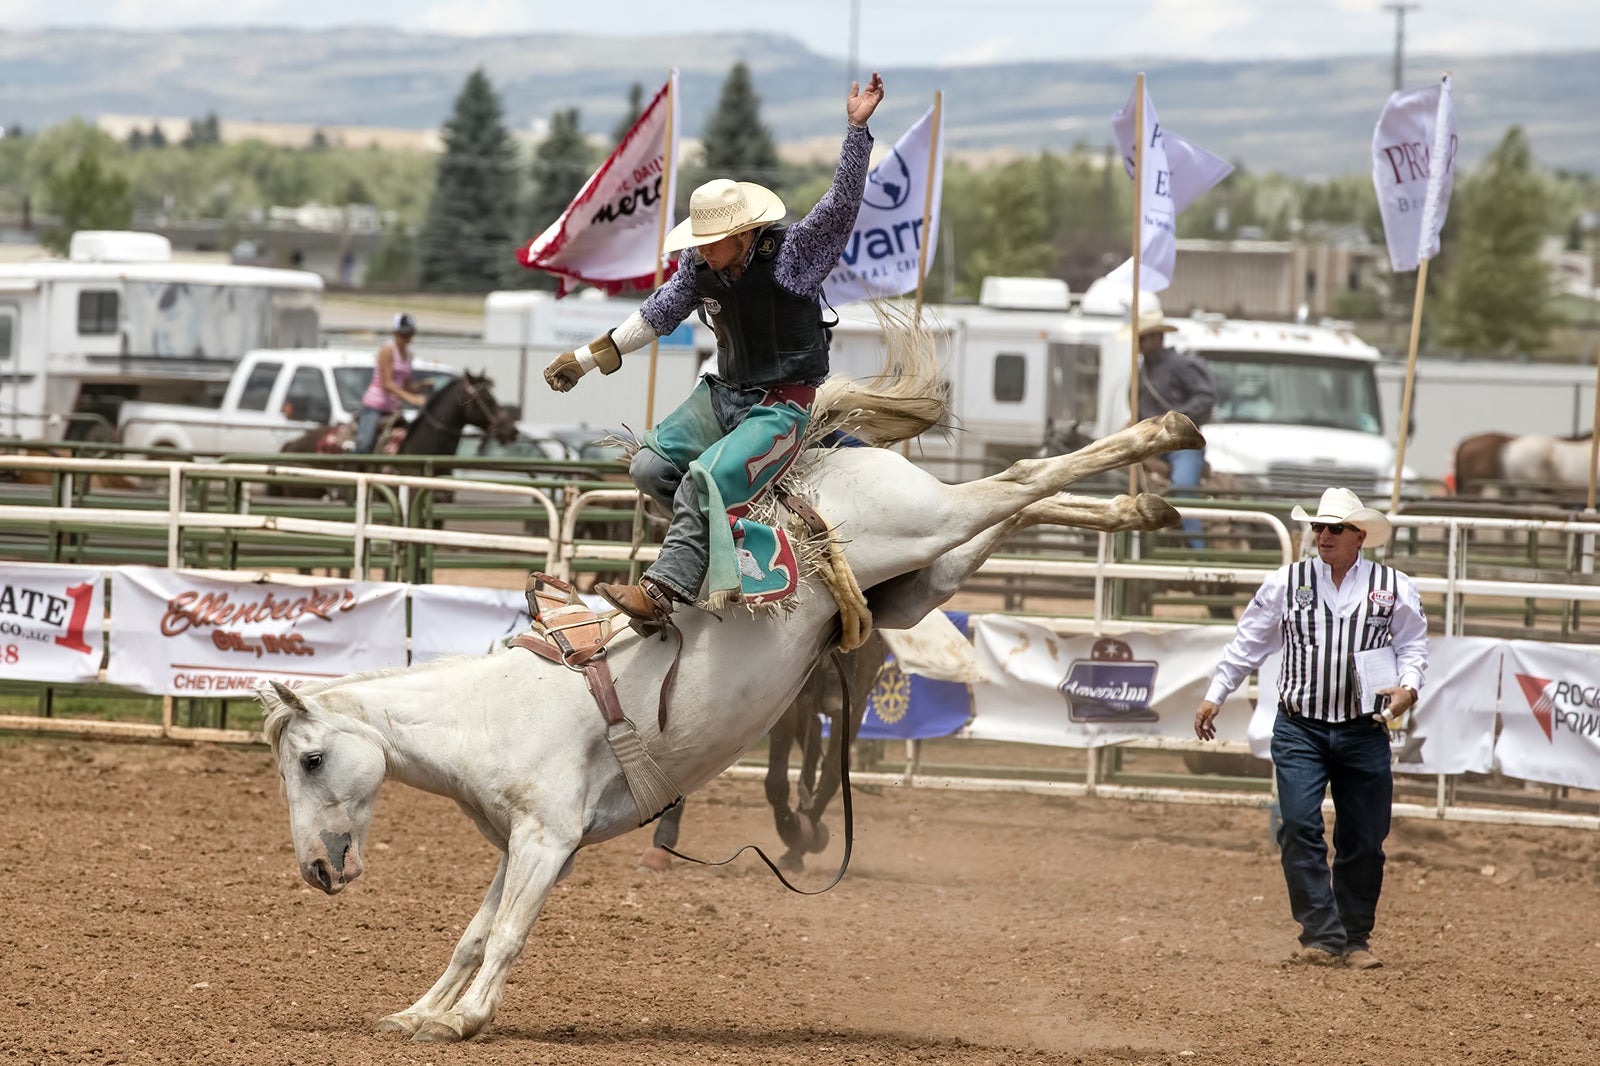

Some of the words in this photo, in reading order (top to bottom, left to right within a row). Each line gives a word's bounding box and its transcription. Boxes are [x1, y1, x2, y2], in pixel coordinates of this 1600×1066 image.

[632, 155, 664, 184] DAIL
[55, 582, 94, 655] 1
[161, 588, 356, 637] Ellenbecker
[0, 643, 20, 664] 8
[173, 673, 258, 690] CHEYENNE
[1555, 708, 1600, 738] POW
